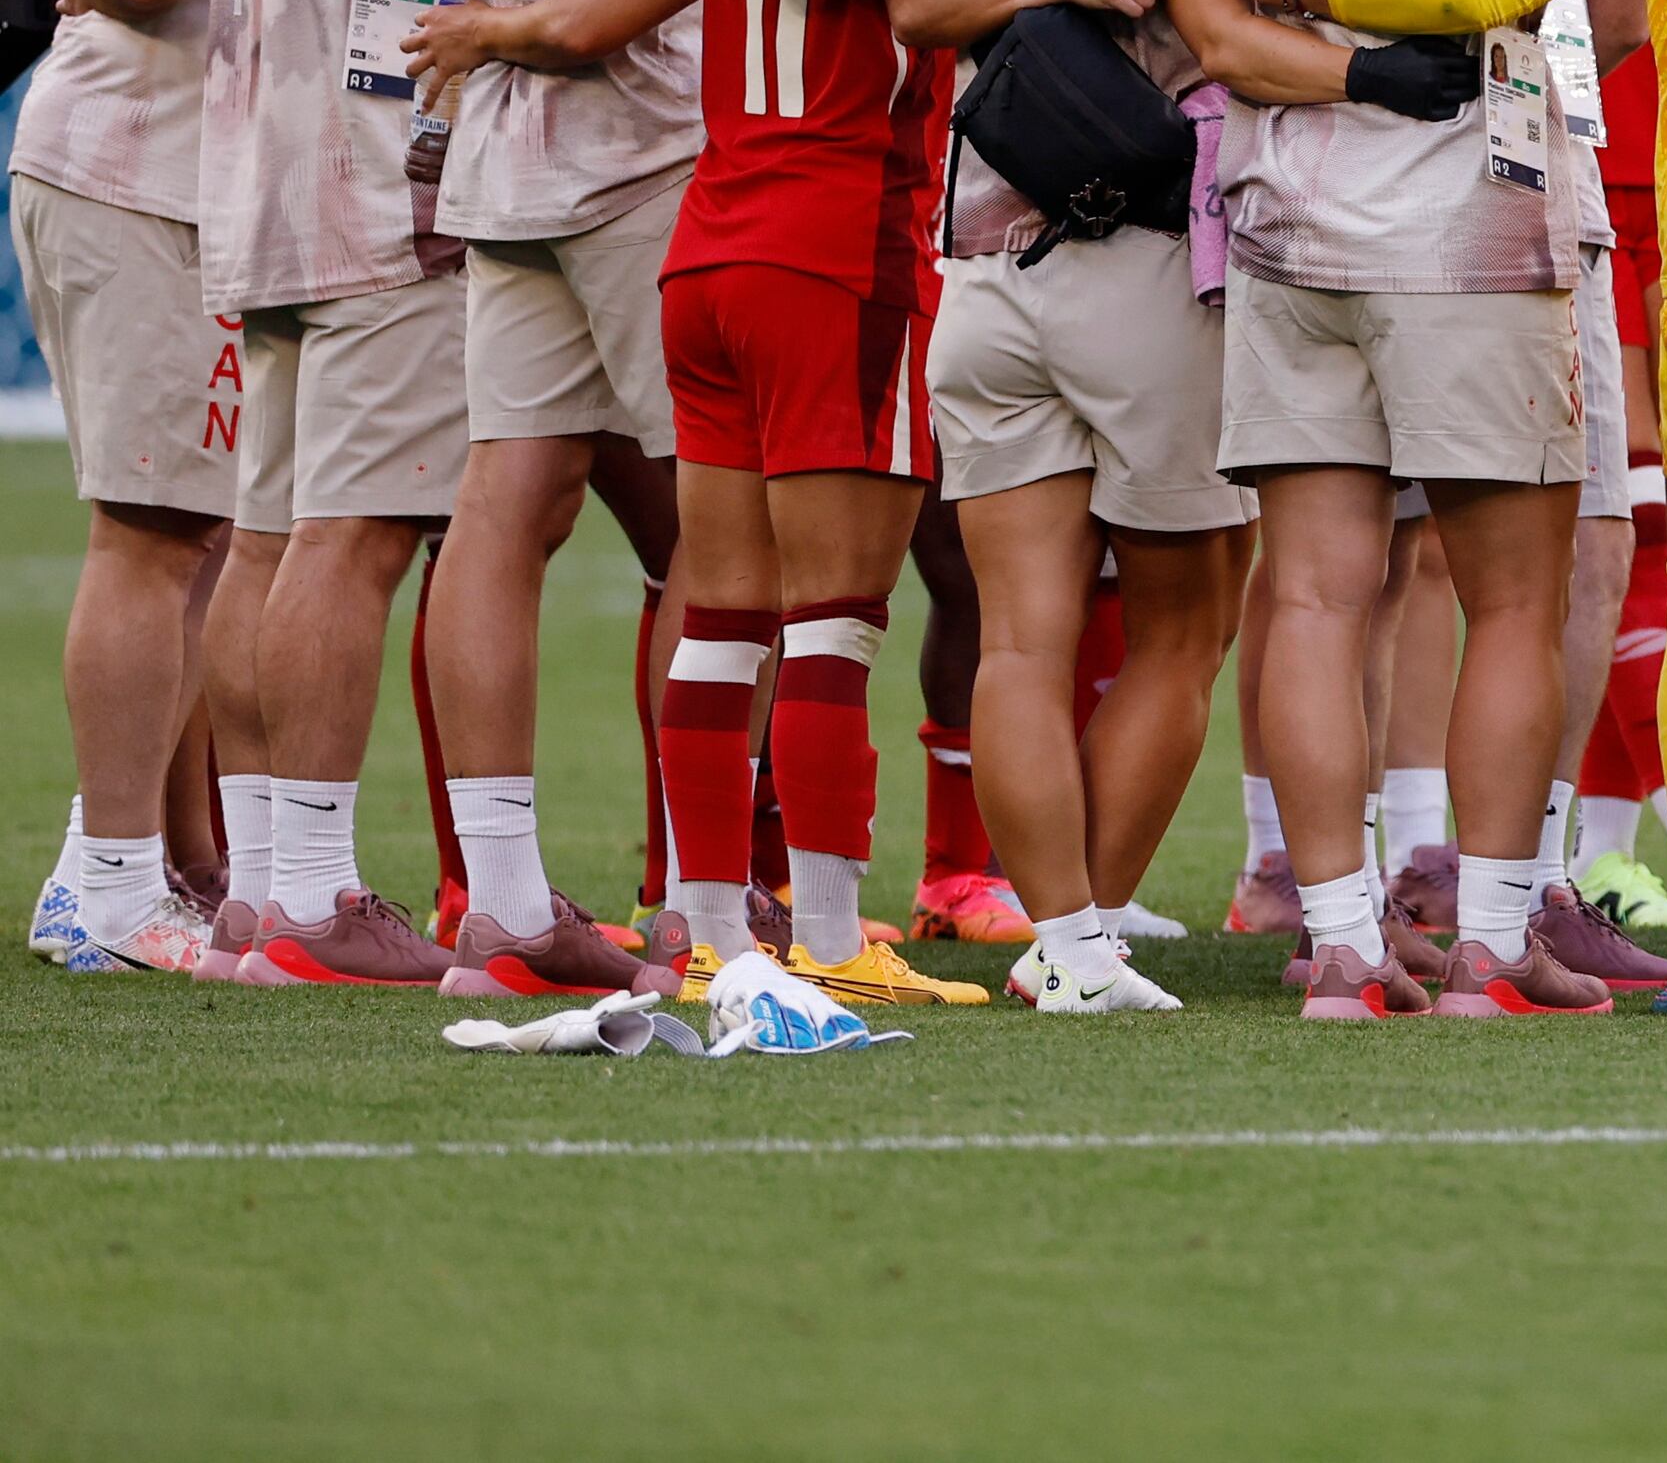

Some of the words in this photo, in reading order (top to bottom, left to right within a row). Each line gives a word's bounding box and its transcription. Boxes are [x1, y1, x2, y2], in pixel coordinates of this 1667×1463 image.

[350, 75, 360, 89] A
[362, 76, 373, 91] 2
[1493, 159, 1502, 175] A
[1502, 161, 1511, 178] 2
[1536, 173, 1545, 189] R
